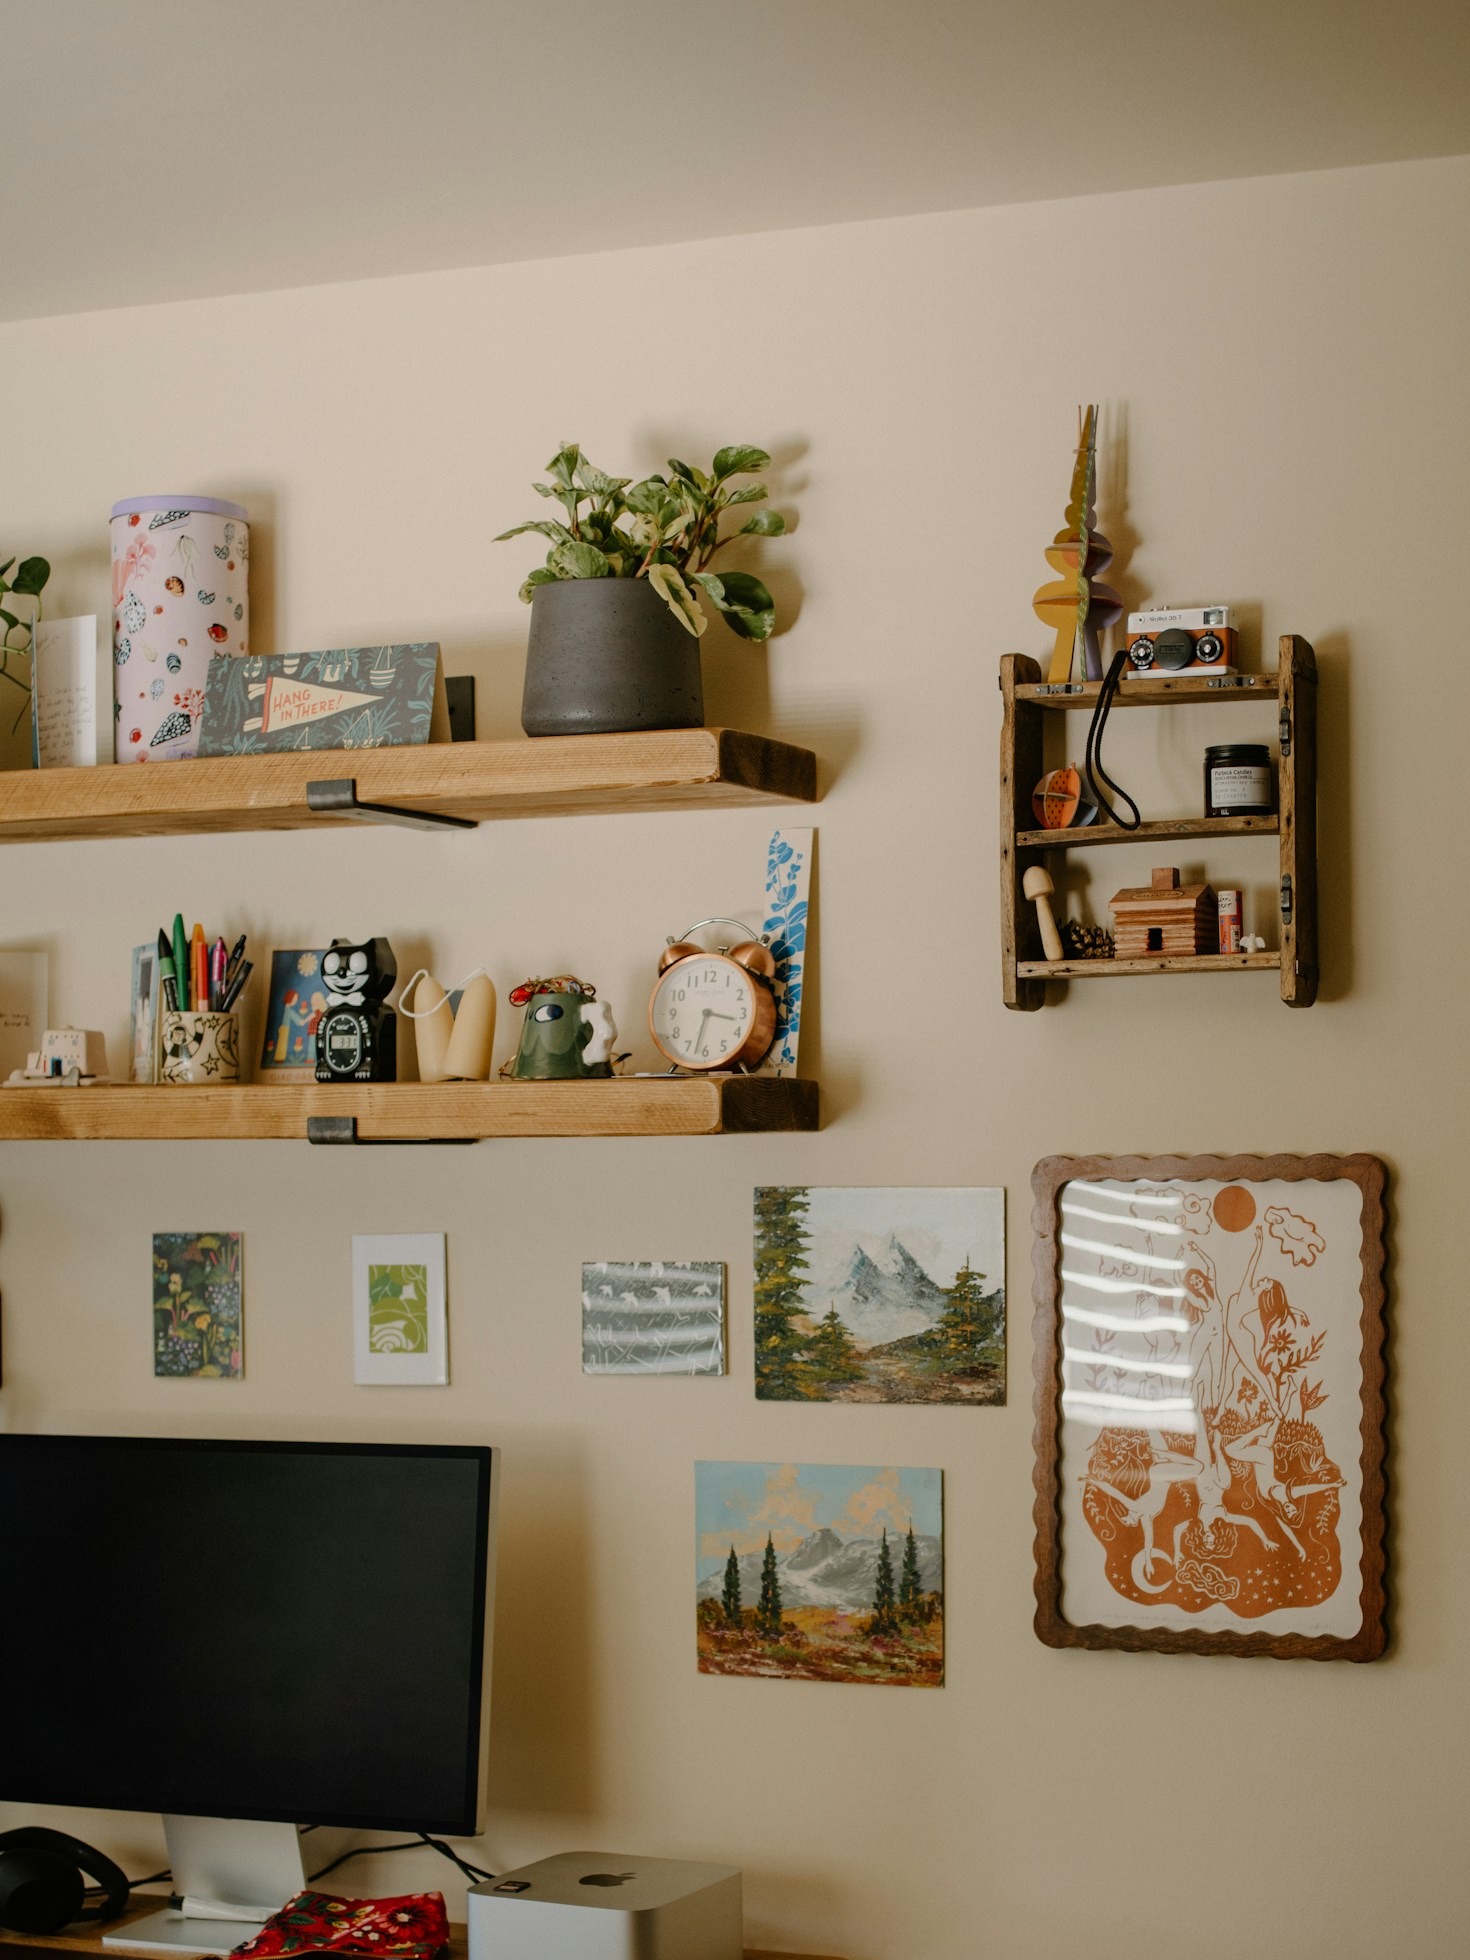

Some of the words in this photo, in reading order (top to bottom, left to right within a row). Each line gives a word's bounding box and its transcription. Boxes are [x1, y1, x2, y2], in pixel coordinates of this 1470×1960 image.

[273, 689, 311, 712] HANG
[280, 709, 292, 722] IN
[294, 693, 343, 720] THERE!
[687, 975, 698, 988] 11
[703, 970, 717, 983] 12
[726, 975, 730, 988] 1
[671, 989, 685, 1002] 10
[736, 988, 744, 1001] 2
[669, 1008, 677, 1020] 9
[739, 1007, 747, 1019] 3
[672, 1026, 680, 1039] 8
[733, 1026, 741, 1038] 4
[684, 1040, 692, 1052] 7
[701, 1045, 709, 1057] 6
[720, 1040, 727, 1052] 5
